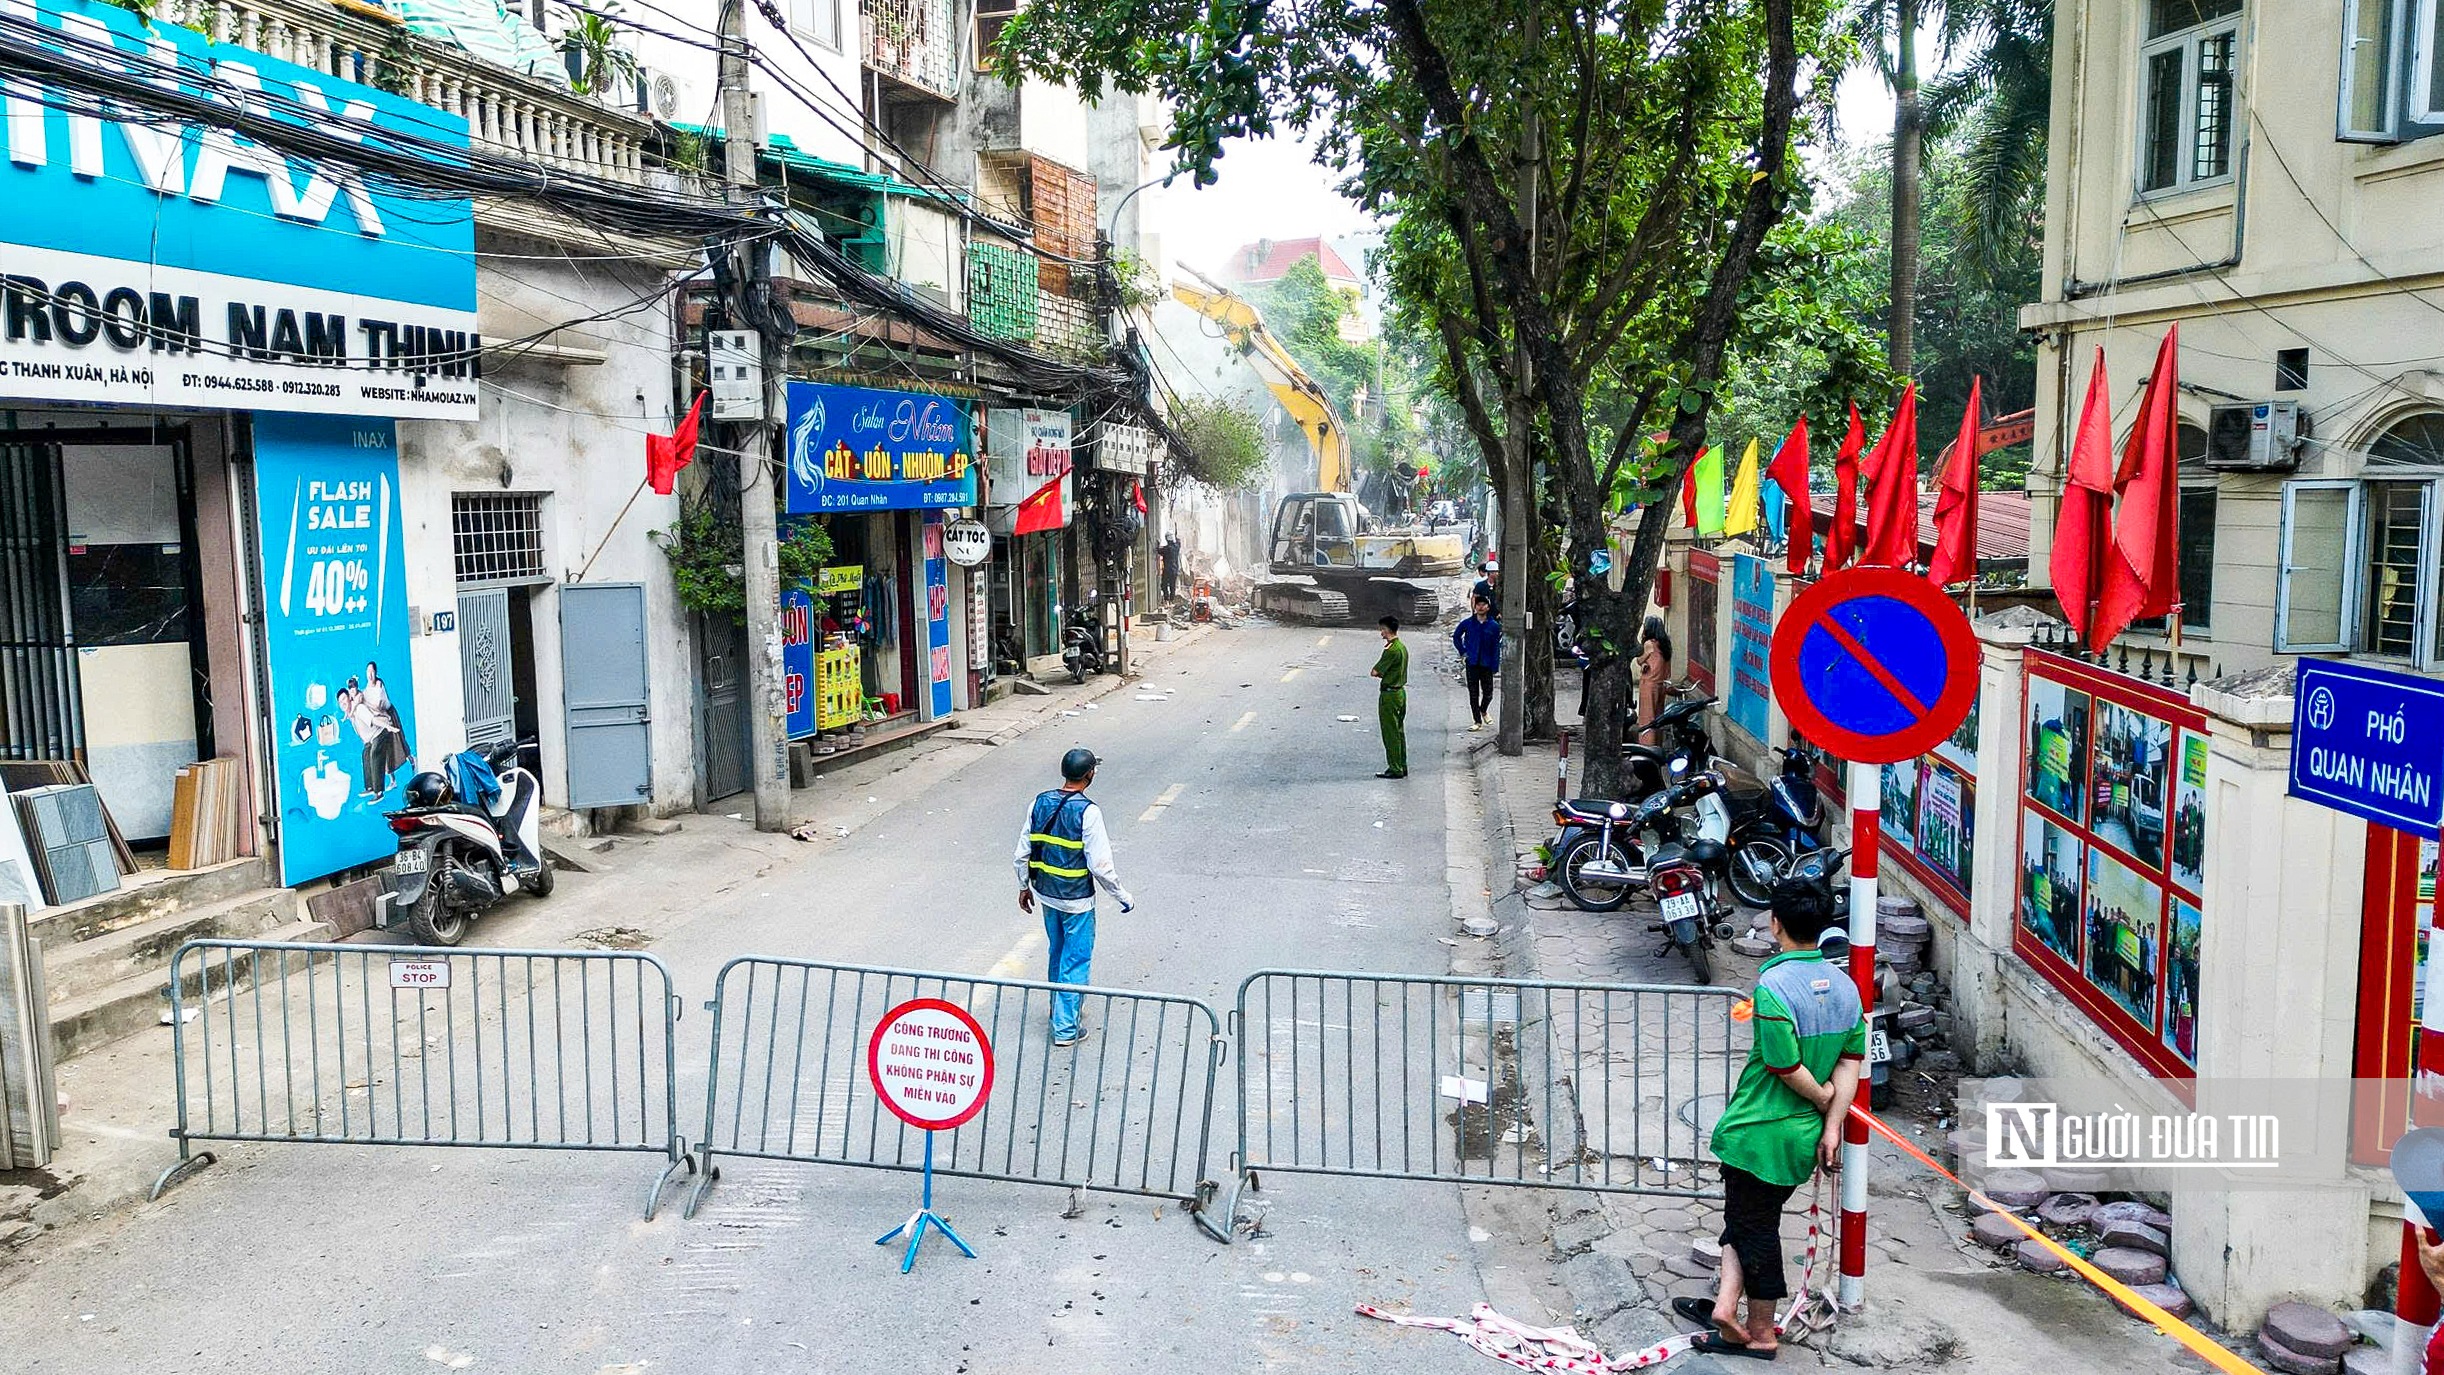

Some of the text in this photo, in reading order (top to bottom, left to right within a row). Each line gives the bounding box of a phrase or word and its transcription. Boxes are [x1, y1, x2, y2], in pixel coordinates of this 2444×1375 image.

[0, 272, 480, 388] ROOM NAM THỊNH
[12, 362, 61, 380] THANH
[65, 363, 108, 387] XUÂN,
[110, 365, 129, 385] HÀ
[133, 367, 154, 390] NỘI
[183, 374, 201, 388] ĐT:
[204, 375, 274, 392] 0944.625.588
[282, 381, 341, 397] 0912.320.283
[853, 399, 886, 434] Salon
[353, 430, 387, 449] INAX
[864, 441, 891, 479] UỐN
[902, 447, 945, 484] NHUỘM
[954, 448, 968, 479] ÉP
[309, 481, 372, 502] FLASH
[837, 494, 849, 507] 201
[851, 493, 869, 506] Quan
[870, 493, 888, 506] Nhân
[307, 504, 371, 530] SALE
[305, 558, 368, 617] 40%
[435, 613, 453, 630] 197
[2366, 702, 2406, 745] PHỐ
[2309, 746, 2431, 808] QUAN NHÂN
[402, 973, 437, 983] STOP
[894, 1021, 971, 1043] CÔNG TRƯỜNG
[924, 1047, 940, 1061] THI
[943, 1049, 974, 1065] CÔNG
[886, 1063, 976, 1090] KHÔNG PHẬN SỰ
[935, 1090, 956, 1105] VÀO
